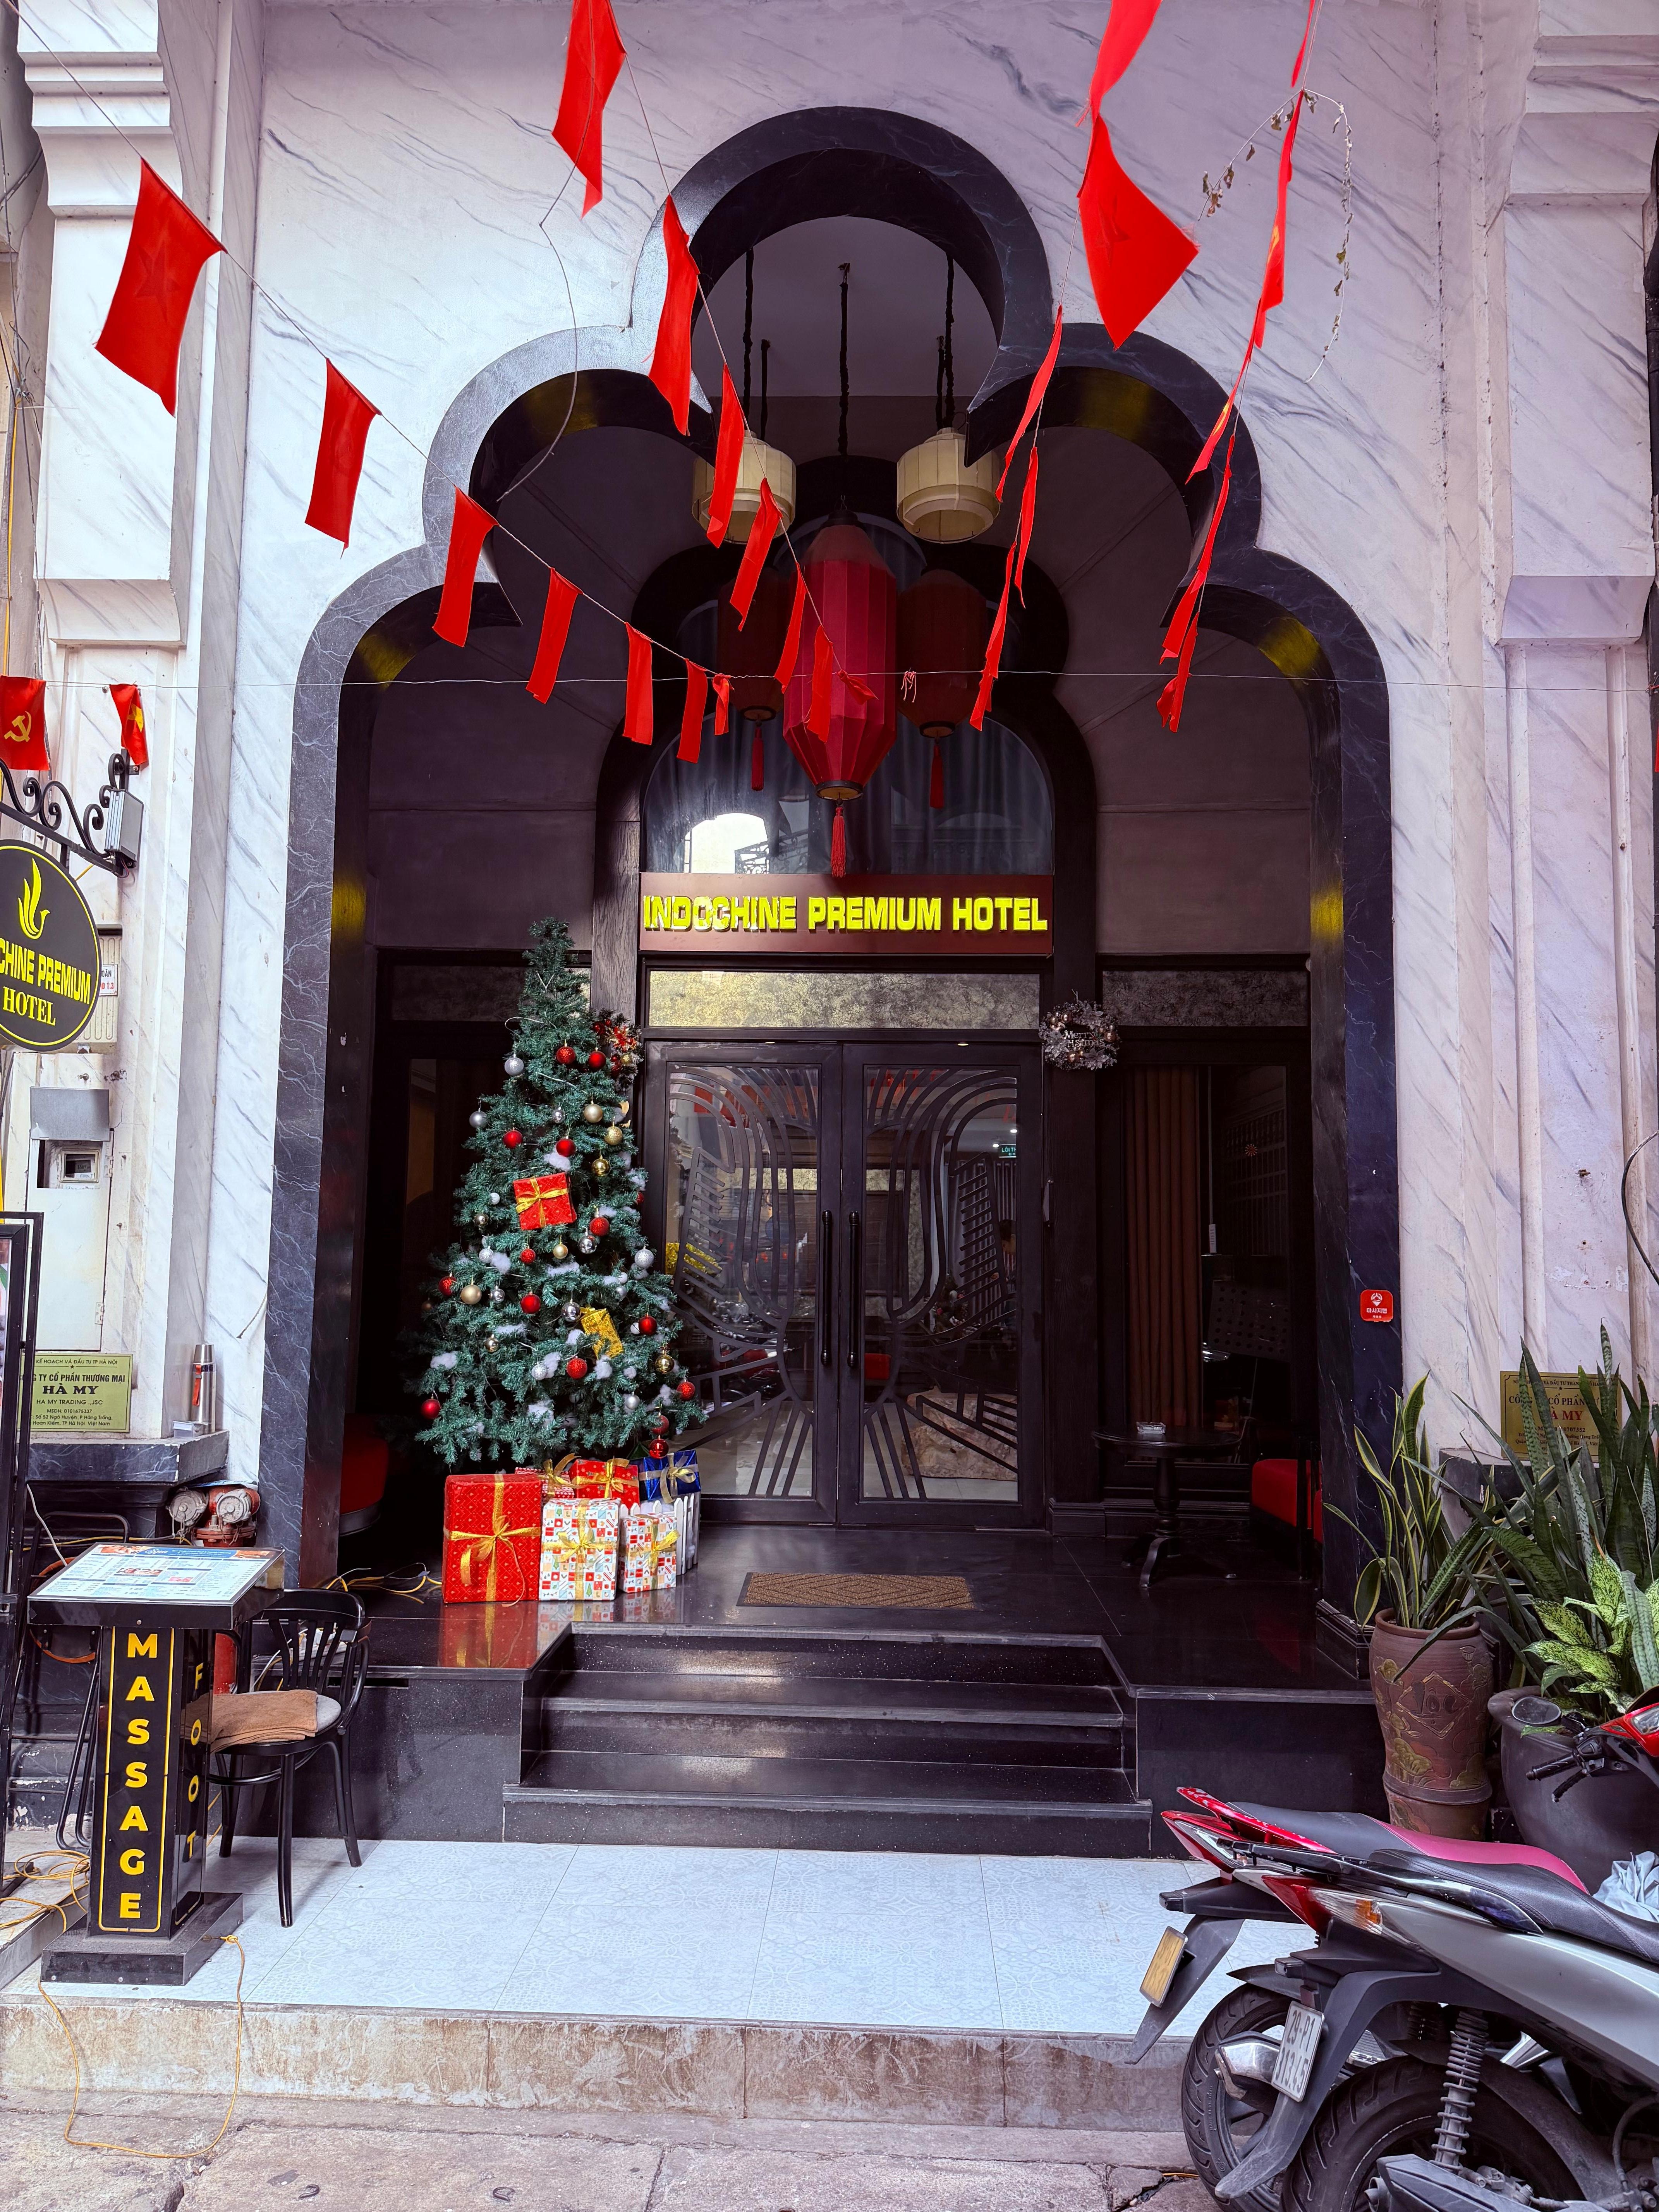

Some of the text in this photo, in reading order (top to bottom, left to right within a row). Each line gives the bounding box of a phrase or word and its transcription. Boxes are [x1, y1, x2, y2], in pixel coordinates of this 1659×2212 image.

[643, 896, 1048, 930] INDOCHINE PREMIUM HOTEL
[38, 953, 91, 1004] PREMIUM
[3, 986, 56, 1026] HOTEL
[43, 1383, 99, 1394] HÀ MY
[112, 1375, 125, 1384] MẠI
[1562, 1395, 1585, 1406] PHẦN
[1562, 1410, 1583, 1420] MY
[118, 1633, 158, 1919] MASSAGE
[187, 1664, 203, 1859] FOOT
[1287, 2010, 1315, 2052] 29-P1
